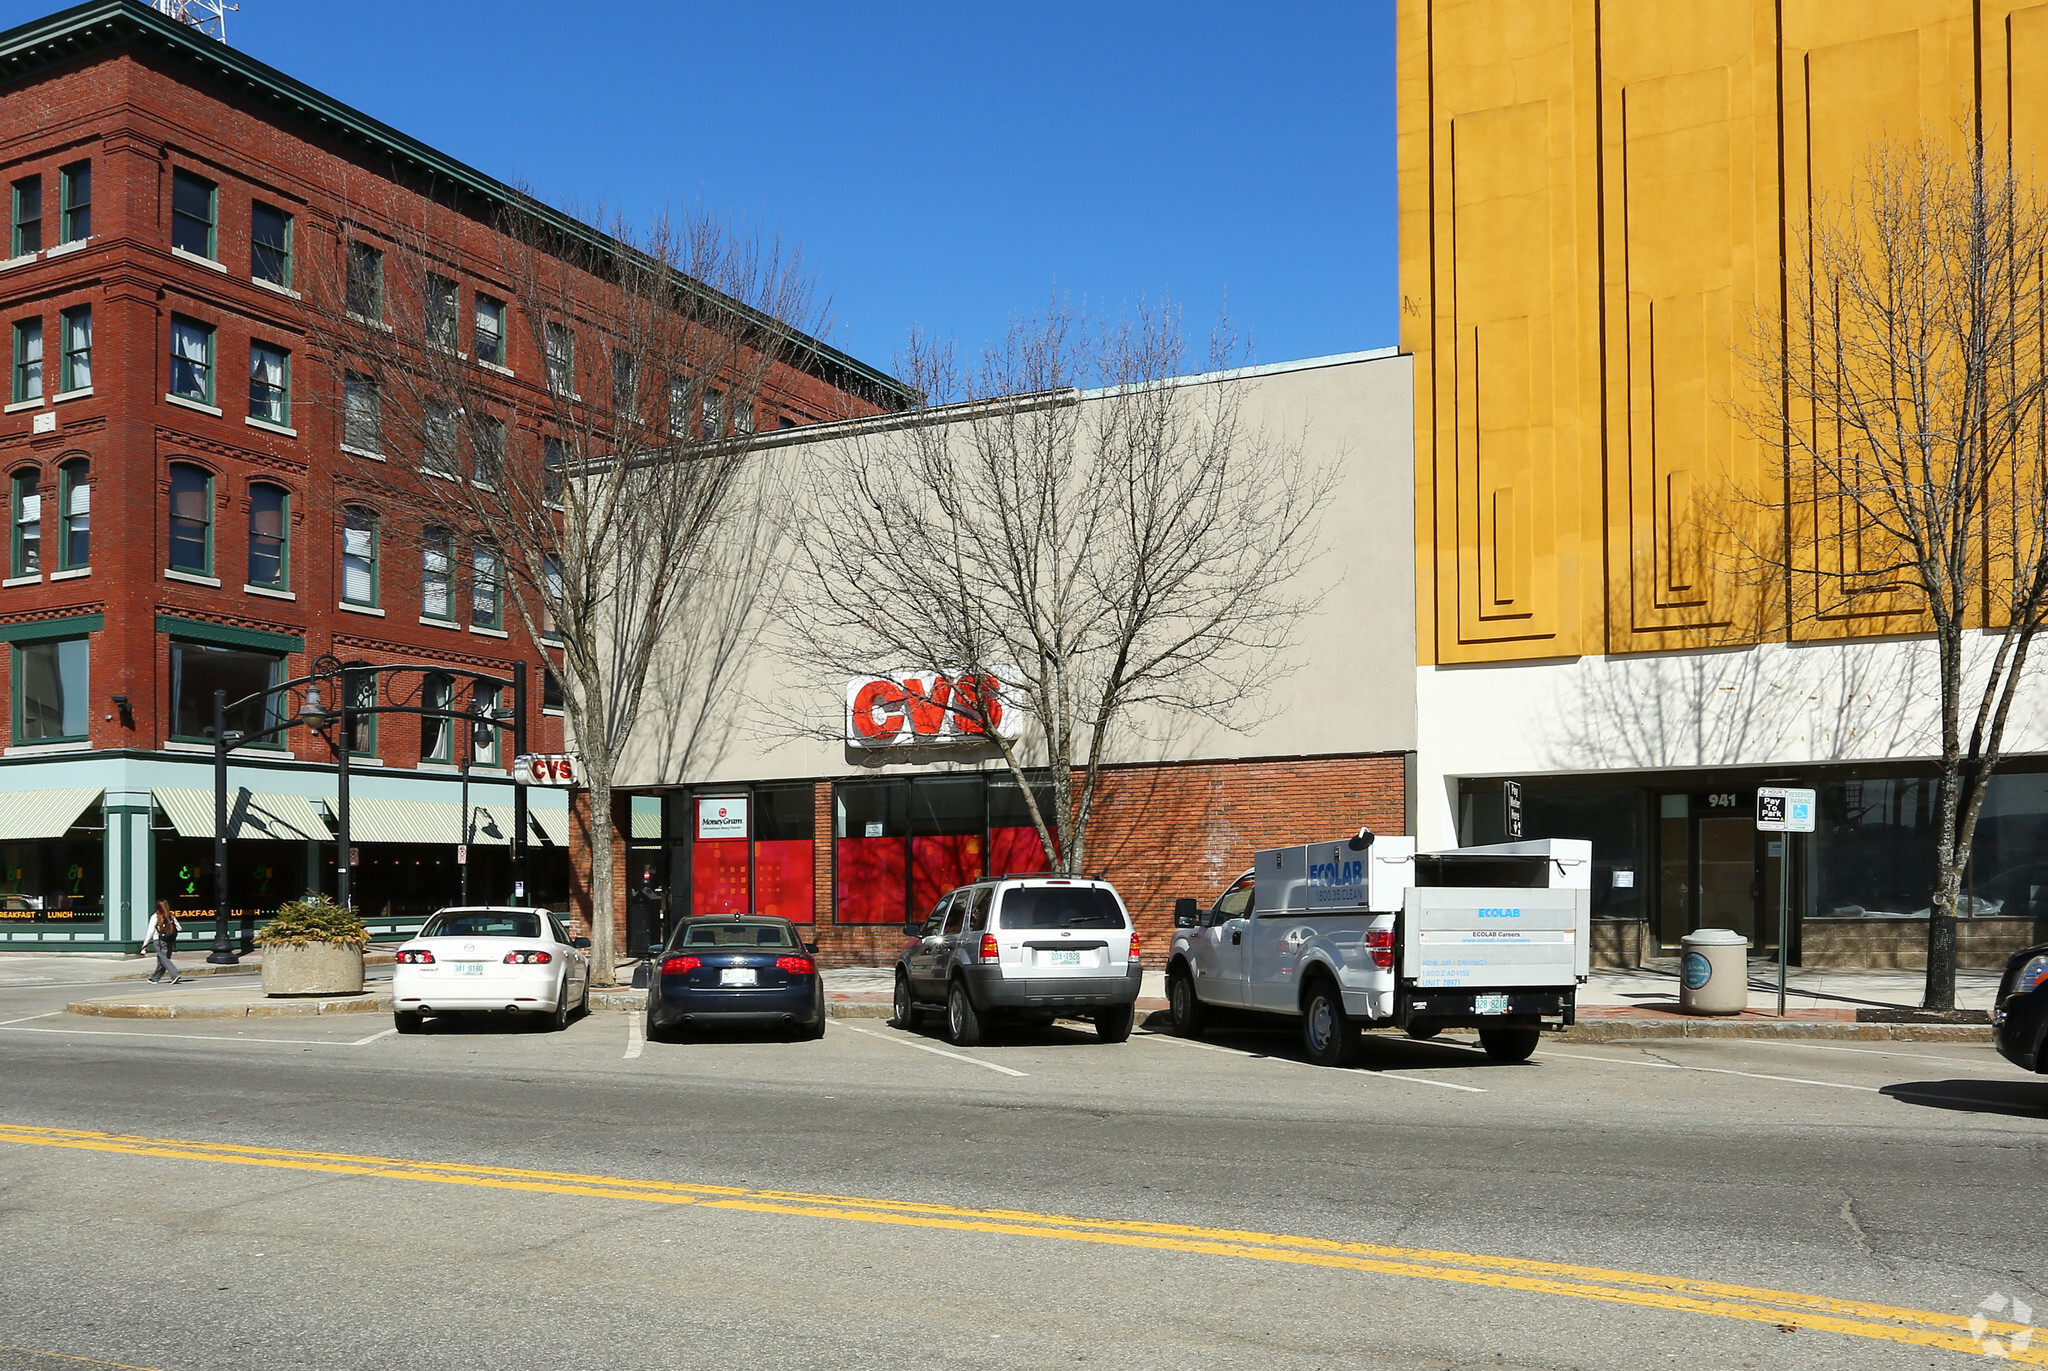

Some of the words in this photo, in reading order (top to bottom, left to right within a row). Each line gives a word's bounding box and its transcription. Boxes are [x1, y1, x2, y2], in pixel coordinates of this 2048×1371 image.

[853, 674, 1003, 739] CVS
[532, 760, 572, 779] CVS
[1709, 794, 1736, 807] 941
[1764, 798, 1780, 806] Pay
[702, 818, 742, 826] MoneyGram
[1310, 861, 1362, 887] ECOLAB
[1478, 909, 1520, 917] ECOLAB
